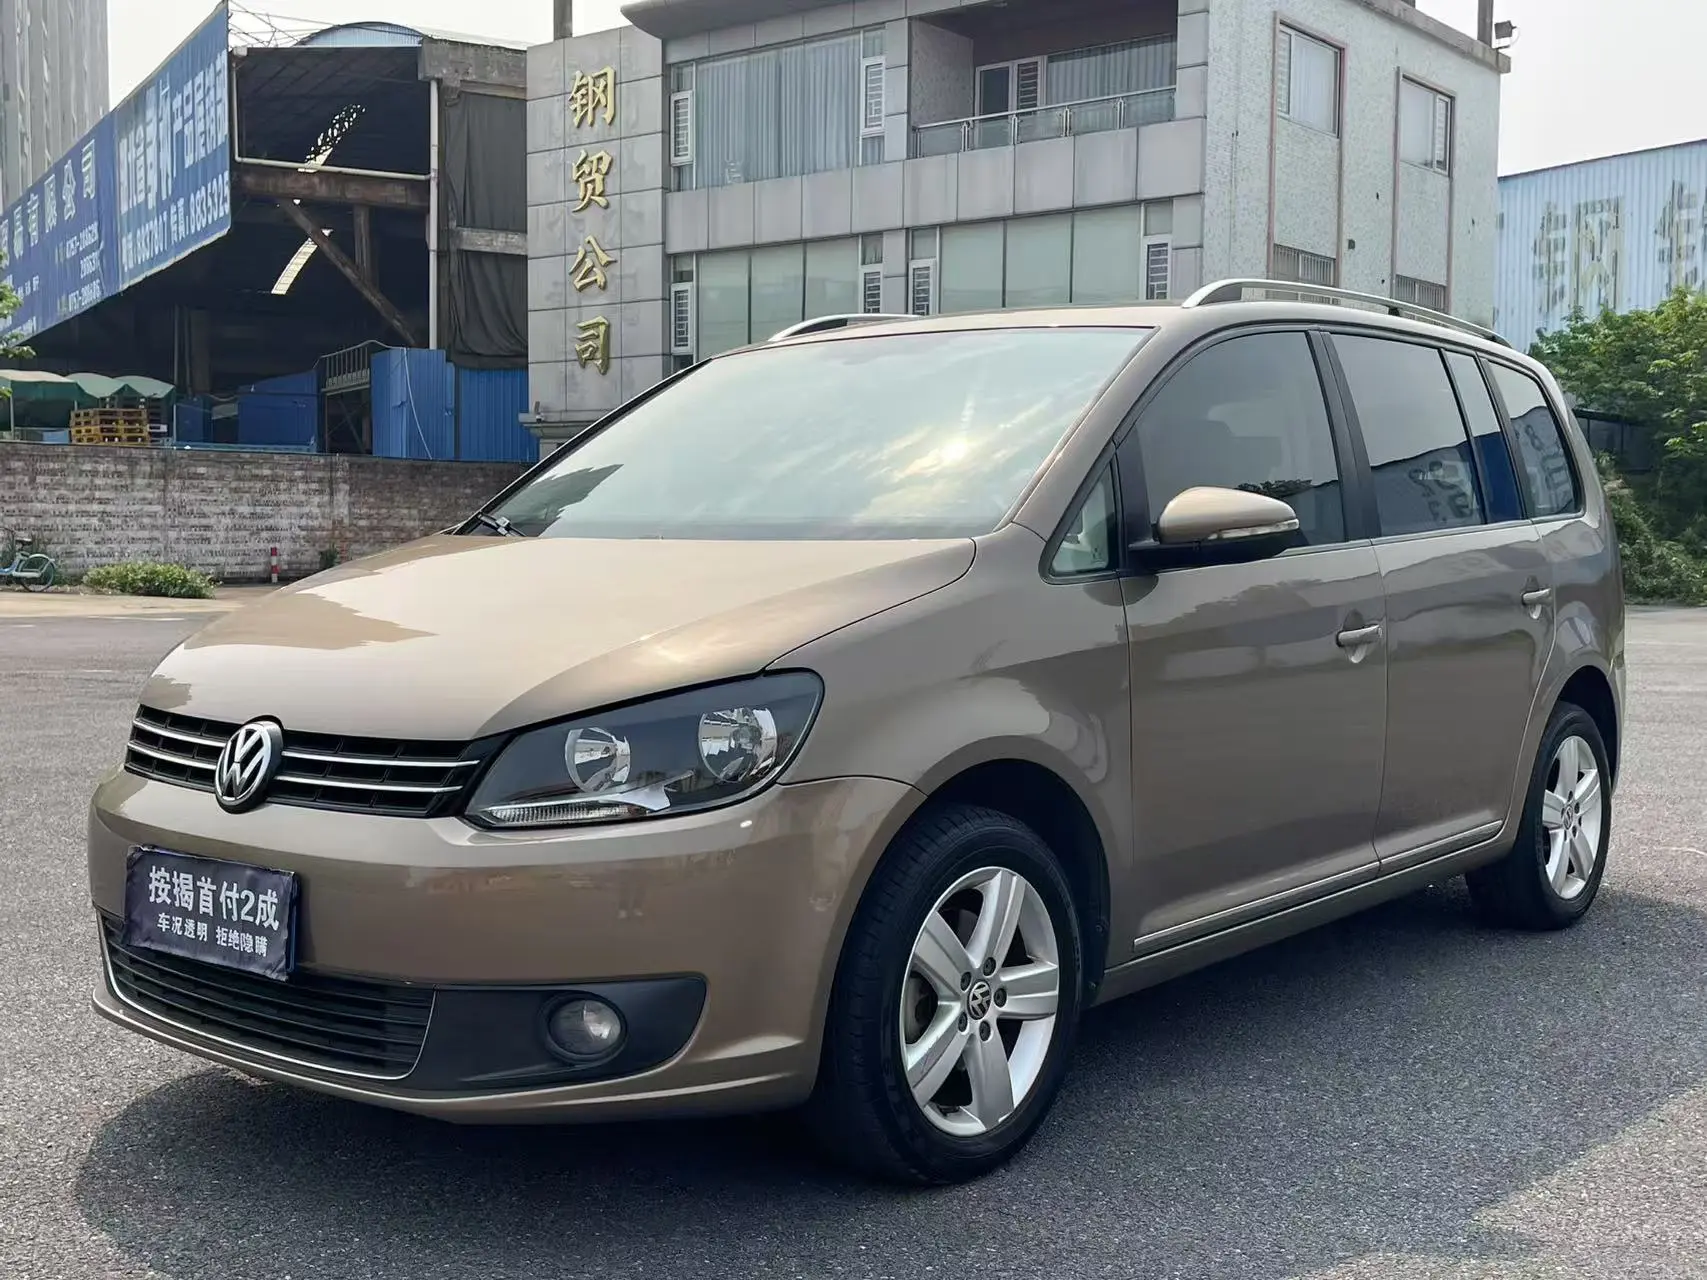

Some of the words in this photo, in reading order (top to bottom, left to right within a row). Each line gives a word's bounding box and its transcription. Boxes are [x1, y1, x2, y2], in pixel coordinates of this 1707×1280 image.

[568, 66, 617, 376] 钢贸公司
[149, 865, 280, 931] 按揭首付2成
[157, 912, 208, 942] 车况透明
[215, 926, 268, 957] 拒绝隐瞒
